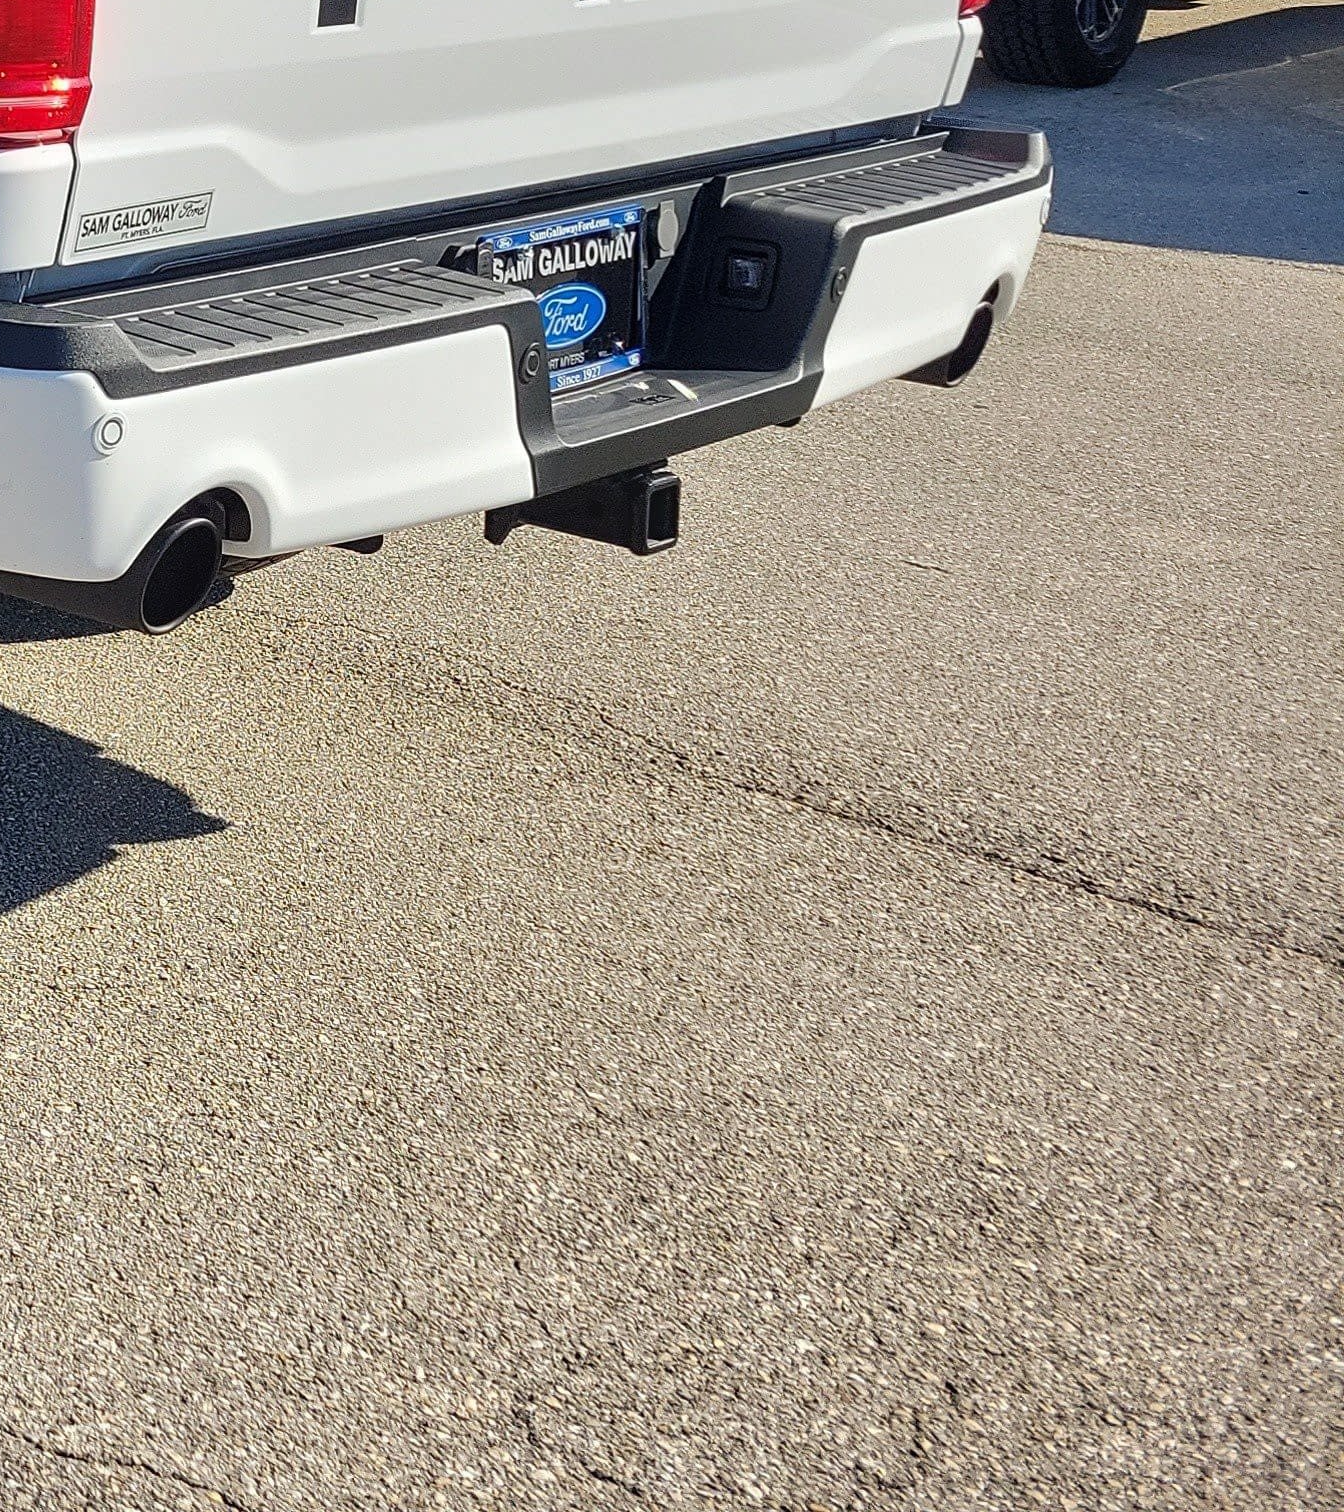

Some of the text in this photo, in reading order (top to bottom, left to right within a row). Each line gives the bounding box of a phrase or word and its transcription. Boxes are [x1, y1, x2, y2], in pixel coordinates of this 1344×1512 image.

[81, 199, 209, 238] SAM GALLOWAY Ford
[529, 217, 610, 242] SamGallowayFord.com
[493, 230, 637, 284] SAM GALLOWAY
[544, 297, 589, 337] Ford
[556, 366, 602, 388] Since 1927
